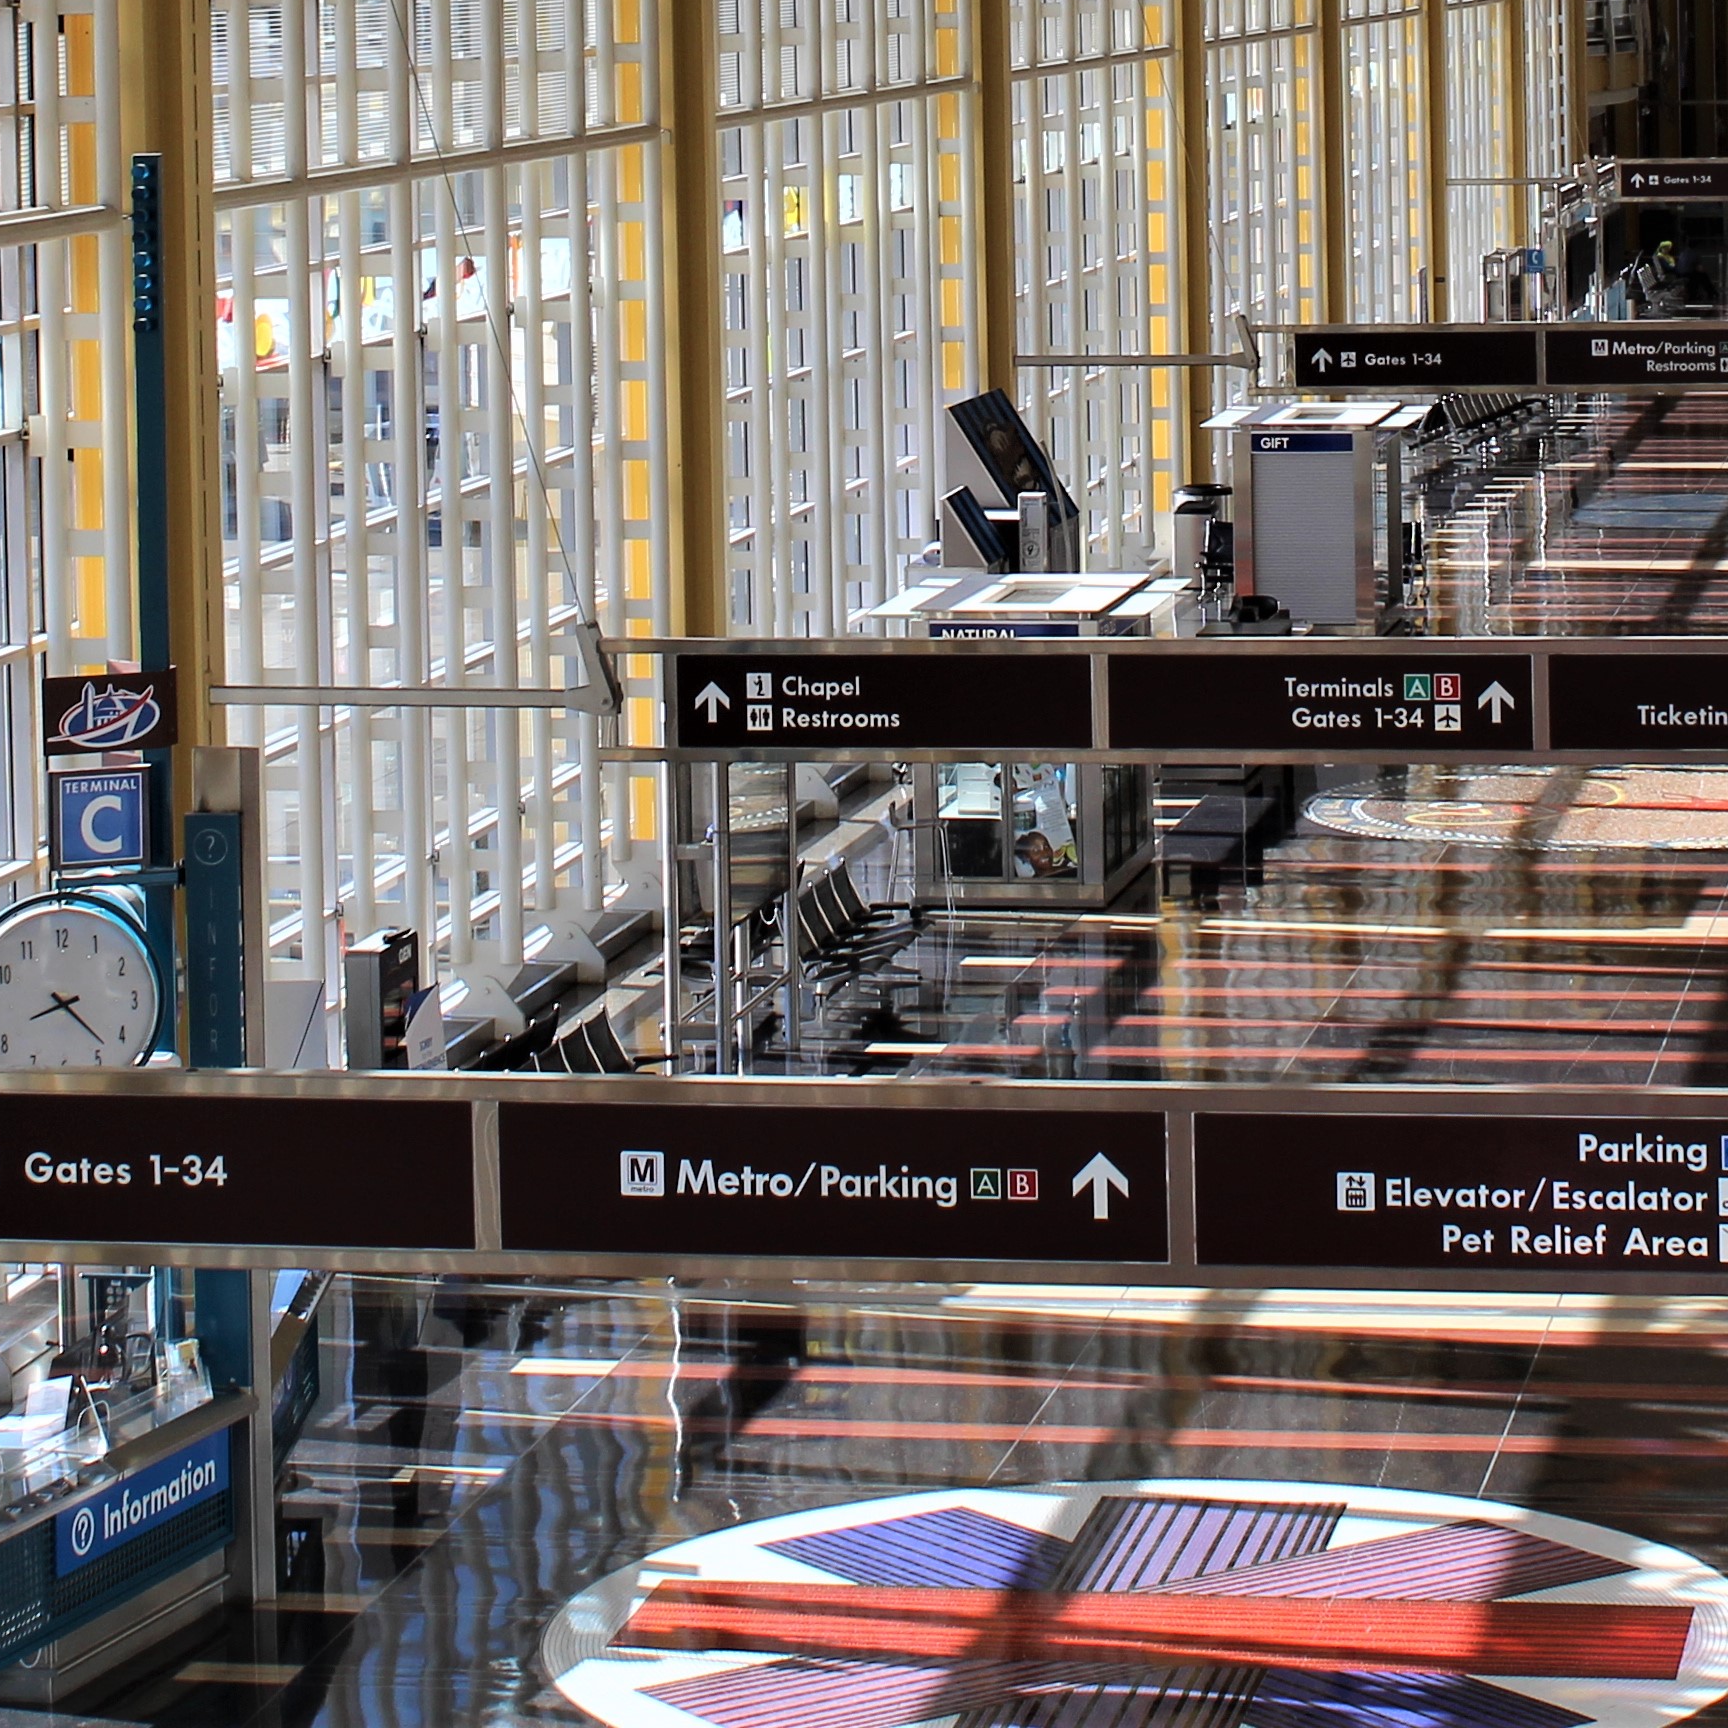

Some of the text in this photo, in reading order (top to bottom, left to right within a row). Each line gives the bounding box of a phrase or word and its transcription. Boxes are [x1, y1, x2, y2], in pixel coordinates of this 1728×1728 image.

[1664, 175, 1712, 184] Gates 1-34
[1613, 342, 1715, 356] Metro/Parking
[1365, 354, 1441, 365] Gates 1-34
[1647, 360, 1715, 371] Restrooms
[1261, 438, 1289, 448] GIFT
[783, 676, 859, 700] Chapel
[1285, 678, 1454, 697] Terminals A B
[783, 708, 899, 727] Restrooms
[1292, 708, 1424, 727] Gates 1-34
[64, 779, 137, 794] TERMINAL
[81, 795, 122, 854] C
[56, 929, 68, 947] 12
[94, 935, 97, 953] 1
[21, 941, 32, 959] 11
[0, 965, 10, 984] 10
[119, 957, 124, 976] 2
[132, 991, 137, 1009] 3
[119, 1026, 125, 1043] 4
[2, 1035, 7, 1053] 8
[96, 1050, 101, 1065] 5
[1579, 1133, 1707, 1171] Parking
[25, 1152, 227, 1186] Gates 1-34
[677, 1159, 956, 1207] Metro/Parking
[976, 1174, 994, 1196] A
[1015, 1175, 1030, 1196] B
[1386, 1178, 1707, 1211] Elevator/Escalator
[1443, 1224, 1708, 1256] Pet Relief Area
[103, 1458, 216, 1539] Information
